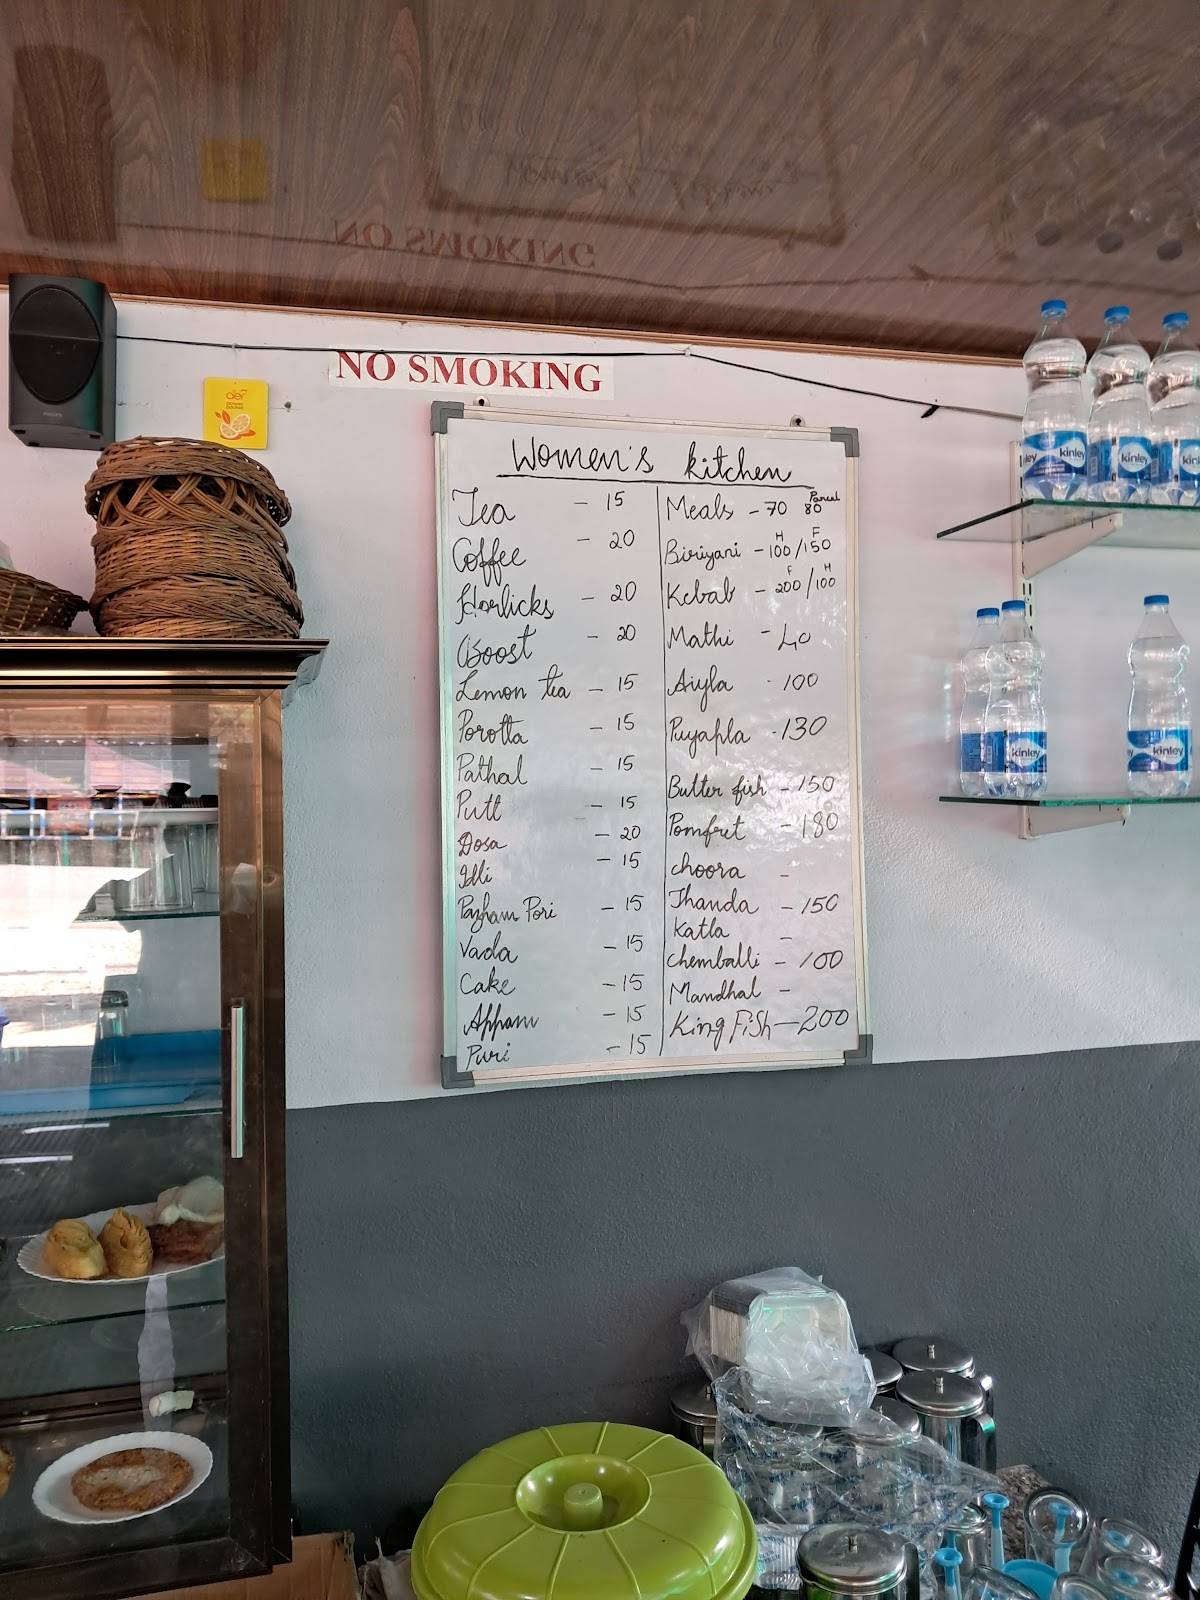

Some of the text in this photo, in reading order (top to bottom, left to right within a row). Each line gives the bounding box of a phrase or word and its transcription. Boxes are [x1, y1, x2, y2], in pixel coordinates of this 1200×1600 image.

[336, 351, 603, 393] NO SMOKING
[512, 437, 654, 473] Women's
[1121, 452, 1149, 465] kinley
[452, 487, 516, 527] Tea
[607, 491, 625, 511] 15
[667, 493, 734, 520] Meals
[764, 501, 787, 517] 70
[805, 503, 822, 515] 80
[812, 526, 820, 538] F
[452, 537, 527, 588] Coffee
[609, 529, 635, 549] 20
[664, 539, 741, 571] Biriyani
[455, 583, 554, 625] Horlicks
[611, 581, 636, 602] 20
[667, 576, 735, 609] Kebab
[457, 624, 536, 668] Boost
[617, 624, 636, 641] 20
[667, 621, 734, 649] Mathi
[778, 623, 811, 651] 40
[456, 670, 527, 702] Lemon
[538, 664, 571, 700] tea
[619, 674, 639, 692] 15
[784, 673, 818, 691] 100
[458, 709, 528, 746] Porotta
[618, 713, 634, 731] 15
[782, 716, 827, 741] 130
[618, 755, 634, 771] 15
[1011, 749, 1041, 758] kinley
[1153, 746, 1184, 757] kinley
[457, 789, 502, 821] Putt
[621, 796, 638, 809] 15
[668, 773, 724, 799] Butter
[732, 775, 768, 807] fish
[798, 776, 835, 793] 150
[458, 831, 507, 857] Dosa
[620, 825, 641, 841] 20
[669, 813, 746, 848] Pomfret
[803, 811, 838, 838] 180
[623, 852, 642, 868] 15
[458, 892, 520, 934] Pazham
[523, 896, 558, 922] Pori
[626, 895, 644, 911] 15
[669, 883, 759, 914] Thanda
[801, 894, 839, 914] 150
[674, 916, 730, 940] Katla
[460, 931, 518, 963] Vada
[627, 935, 643, 952] 15
[800, 950, 843, 970] 100
[460, 966, 516, 995] Cake
[624, 973, 644, 992] 15
[670, 975, 761, 1005] Mandhal
[463, 1003, 539, 1042] Appam
[627, 1004, 646, 1023] 15
[669, 1010, 725, 1051] King
[798, 1006, 849, 1035] 200
[466, 1043, 510, 1071] Puri
[630, 1033, 652, 1055] 15
